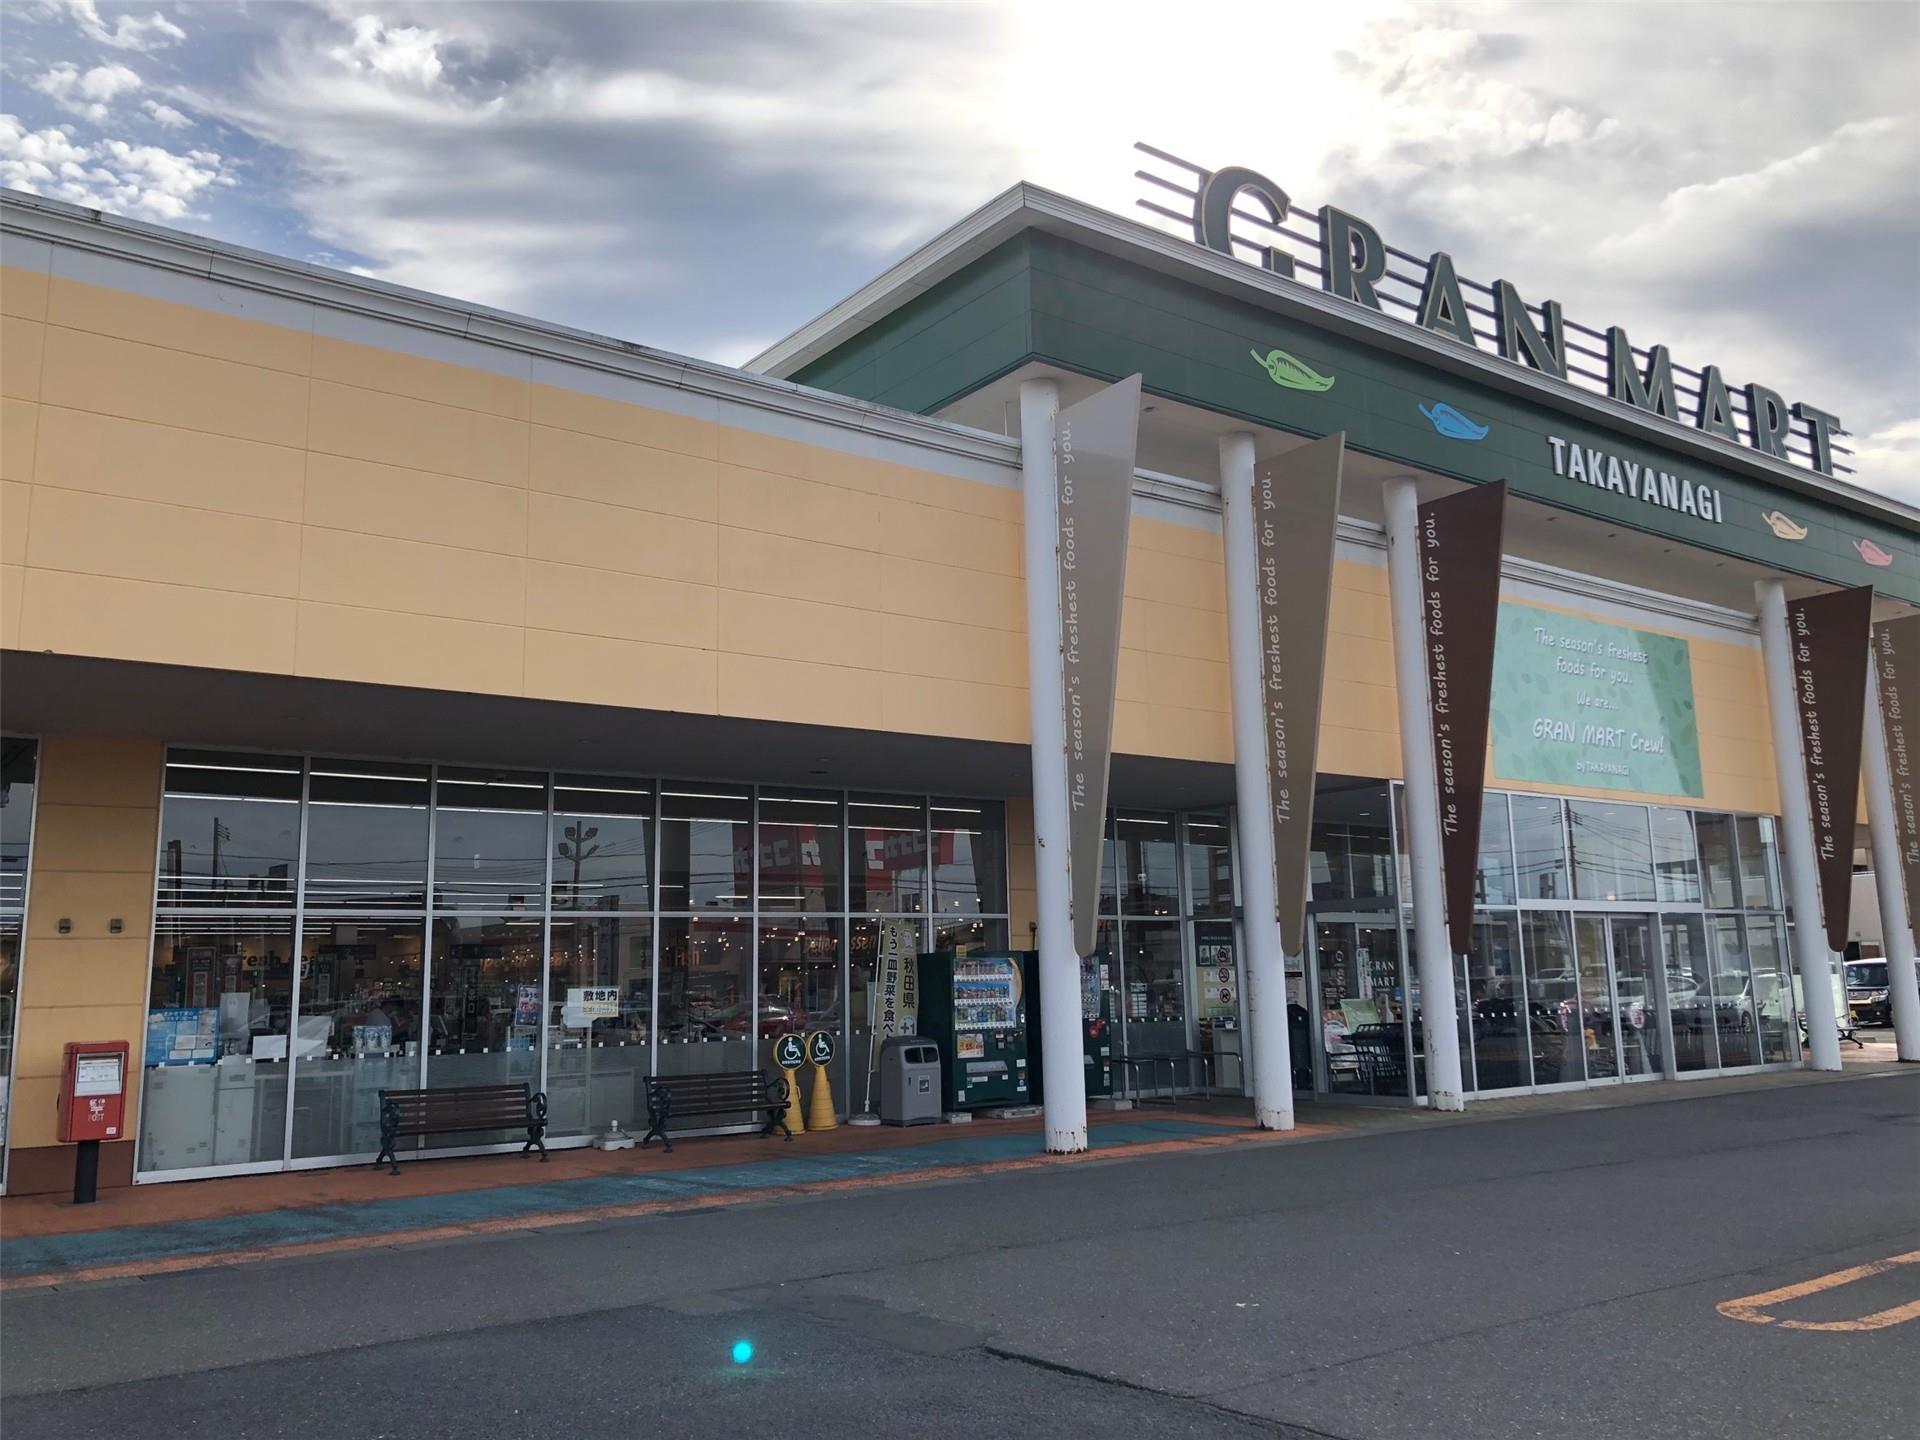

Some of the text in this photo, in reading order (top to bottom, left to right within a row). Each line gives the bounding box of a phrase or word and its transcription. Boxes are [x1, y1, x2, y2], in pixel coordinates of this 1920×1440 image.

[1193, 165, 1842, 476] GRAN MART
[1547, 435, 1723, 524] TAKAYANAGI
[1061, 421, 1085, 811] The season's freshest foods for you.
[1261, 471, 1290, 824] The season's freshest foods for you.
[1534, 627, 1649, 664] The season's freshest
[1556, 656, 1633, 685] foods for you.
[1425, 512, 1458, 836] The season's freshest foods for you.
[1576, 691, 1591, 706] We
[1533, 718, 1665, 753] GRAN MART Crew!
[1795, 607, 1835, 860] The season's freshest foods for you.
[1880, 628, 1920, 865] The season's freshest foods for you.
[882, 926, 899, 1039] もう一皿野菜を食べ
[903, 957, 915, 1009] 秋田県
